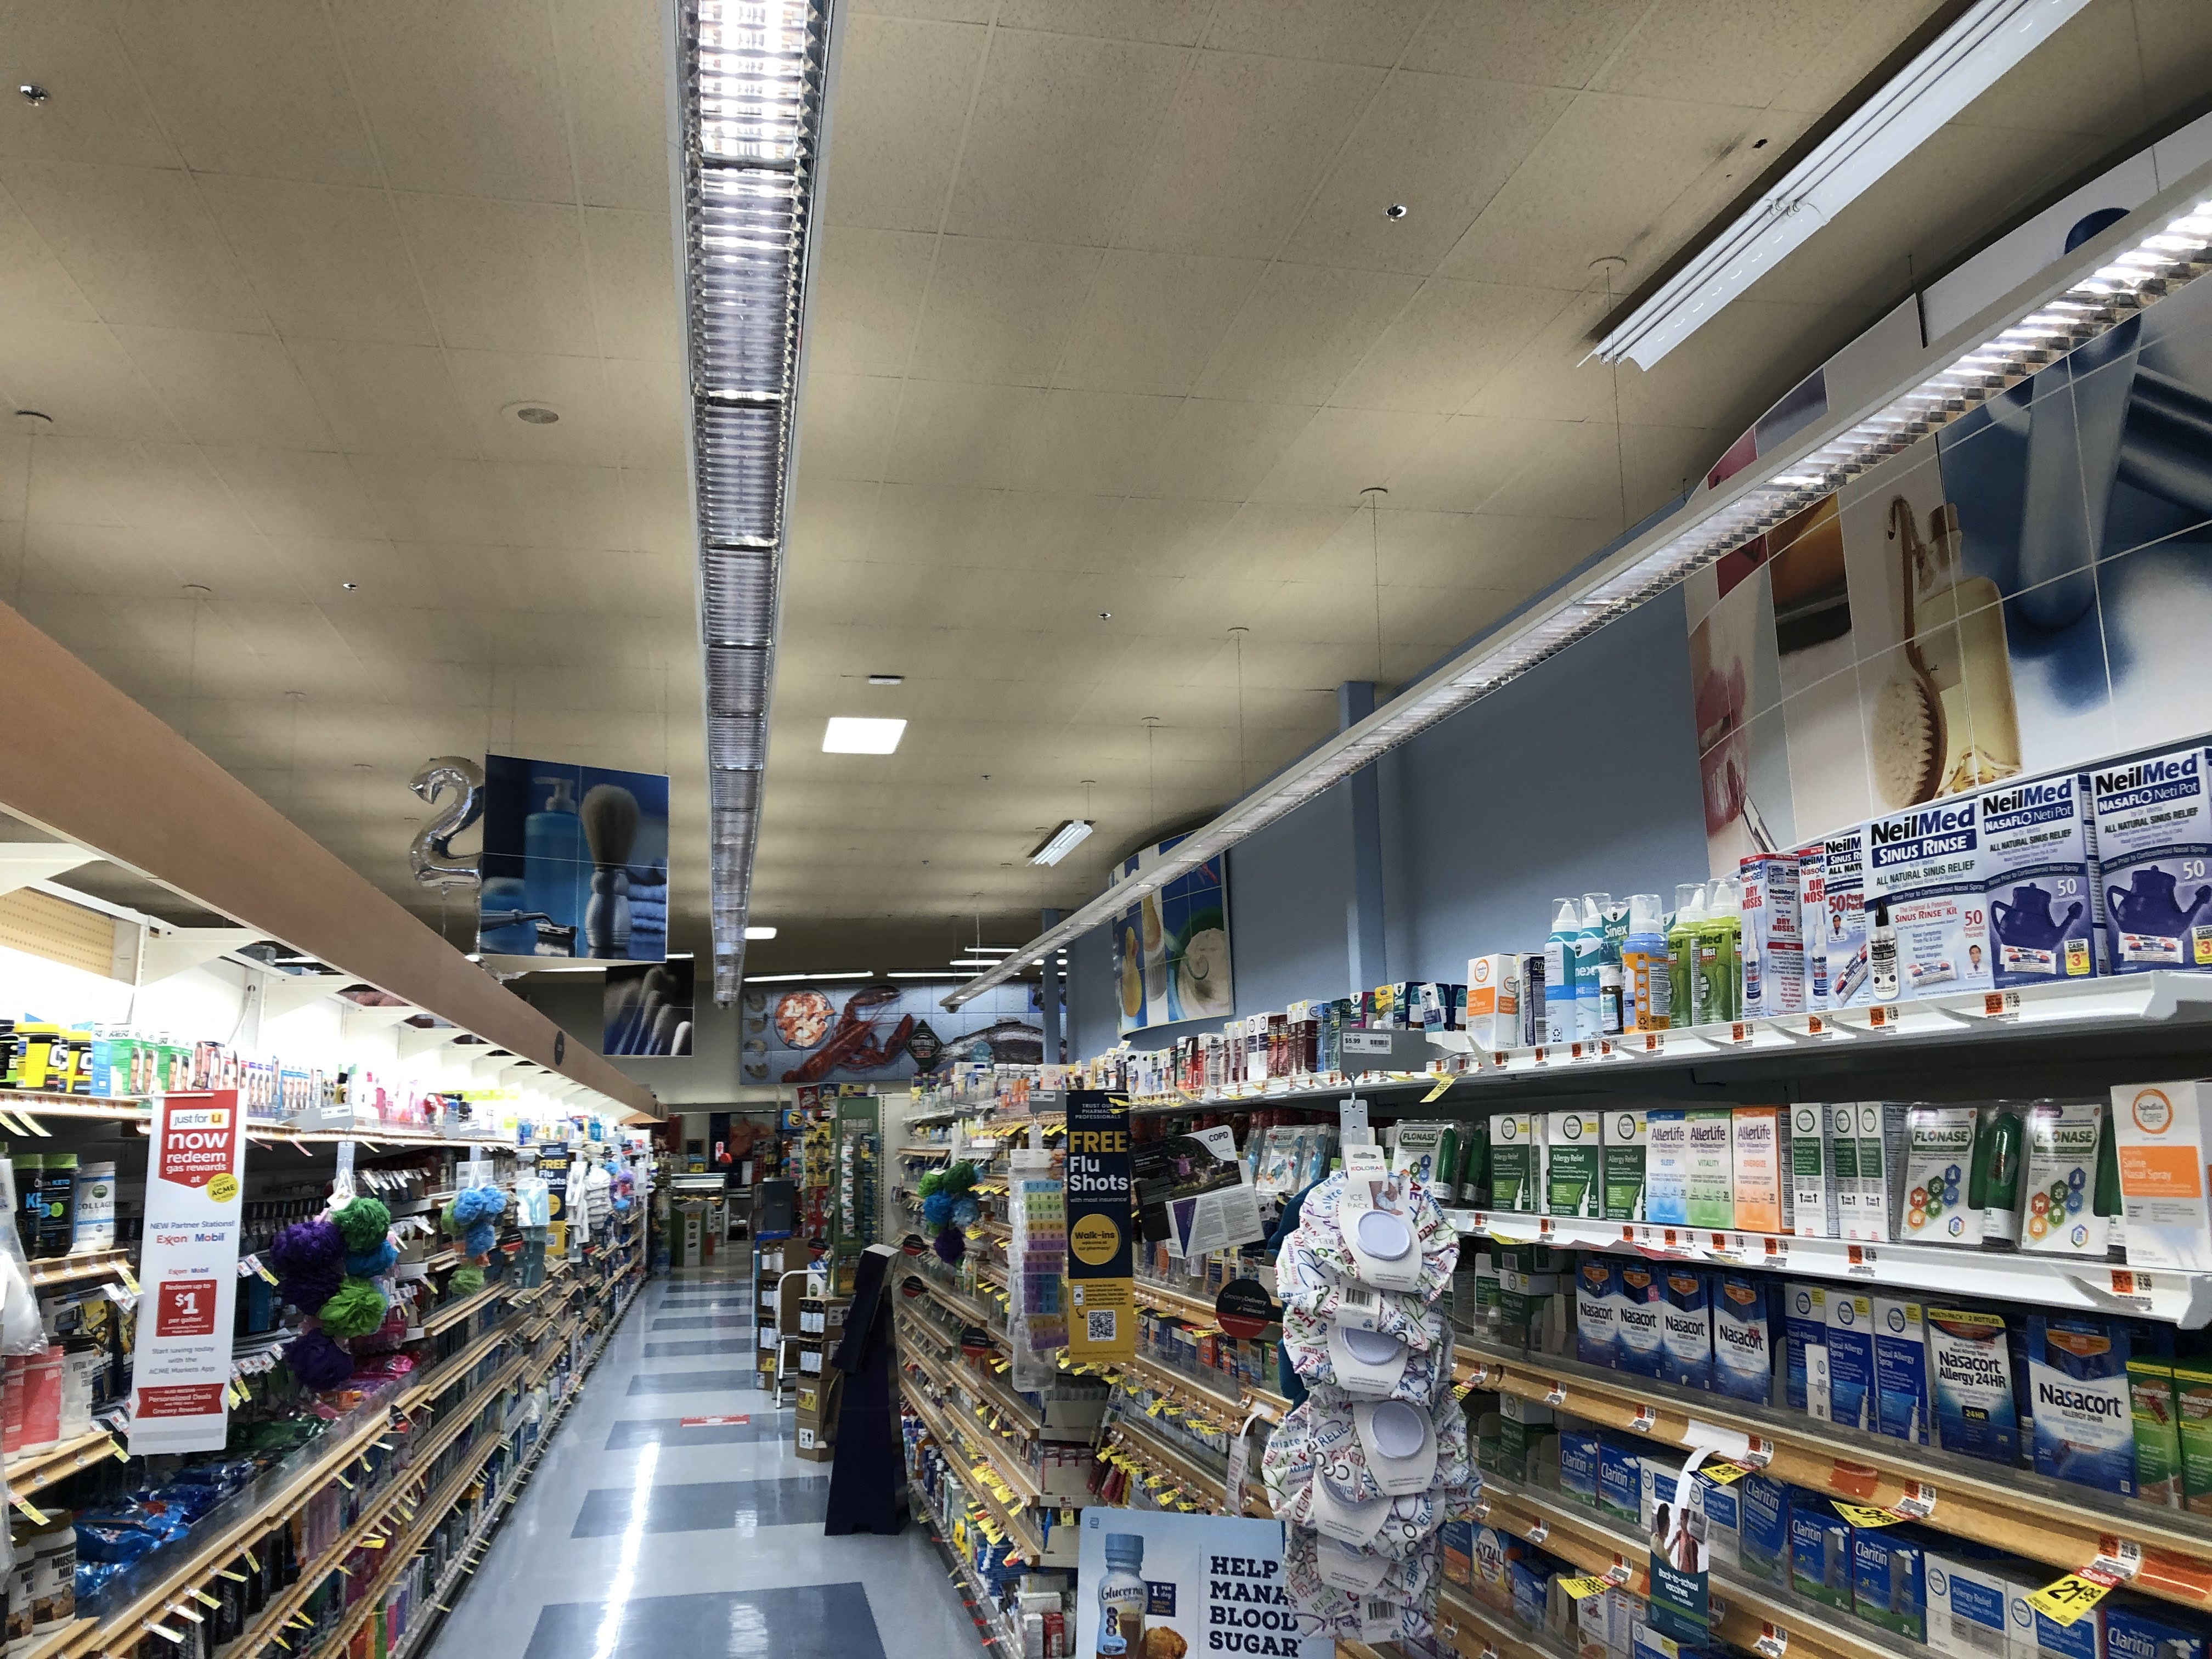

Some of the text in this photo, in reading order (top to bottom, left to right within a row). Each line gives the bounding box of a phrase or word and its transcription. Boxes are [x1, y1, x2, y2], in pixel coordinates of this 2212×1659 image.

[2095, 753, 2197, 795] NeilMed
[1983, 778, 2072, 816] NeilMed
[2100, 782, 2198, 812] NASAFLO Neti Pot
[1871, 803, 1975, 846] NeilMed
[1985, 805, 2072, 831] NASAFLO Neti Pot
[2104, 807, 2198, 833] ALL NATURAL SINUS RELIEF
[2002, 838, 2028, 849] NATURAL
[2030, 833, 2048, 844] SINUS
[2050, 829, 2072, 840] RELIEF
[1879, 836, 1967, 864] SINUS RINSE
[1740, 861, 1763, 874] NeilMed
[1830, 853, 1851, 865] SINUS
[1829, 866, 1842, 875] ALL
[1877, 860, 1974, 885] ALL NATURAL SINUS RELIEF
[2182, 860, 2205, 879] 50
[1746, 885, 1758, 898] DRY
[2058, 878, 2076, 896] 50
[1742, 896, 1762, 911] NOSES
[1829, 895, 1846, 914] 50
[1895, 907, 1957, 923] SINUS RINSE Kit
[1965, 910, 1983, 927] 50
[1605, 924, 1628, 938] Sinex
[1772, 924, 1795, 933] NOSES
[1872, 942, 1895, 952] NeilMed
[174, 1114, 222, 1125] just for u
[167, 1132, 229, 1149] now
[1069, 1131, 1127, 1153] FREE
[1209, 1131, 1228, 1142] COPD
[1914, 1130, 1968, 1142] FLONASE
[2036, 1131, 2092, 1143] FLONASE
[166, 1150, 226, 1163] redeem
[539, 1159, 567, 1169] FREE
[1070, 1155, 1100, 1172] Flu
[1553, 1155, 1570, 1163] Allergy
[1608, 1155, 1624, 1164] Allergy
[2123, 1158, 2146, 1167] Saline
[166, 1163, 227, 1174] gas rewards
[2124, 1169, 2171, 1181] Nasal Spray
[190, 1175, 200, 1183] at
[1070, 1174, 1128, 1191] Shots
[212, 1184, 235, 1197] ACME
[156, 1233, 224, 1246] Exxon Mobil
[1075, 1231, 1115, 1239] Walk-ins
[175, 1293, 199, 1314] $1
[1581, 1302, 1613, 1321] Nasacort
[1621, 1308, 1657, 1328] Nasacort
[1666, 1316, 1705, 1336] Nasacort
[1719, 1324, 1763, 1351] Nasacort
[1844, 1344, 1863, 1355] Allergy
[1894, 1351, 1914, 1364] Allergy
[1939, 1351, 2001, 1374] Nasacort
[1939, 1367, 2006, 1389] Allergy 24HR
[2040, 1383, 2121, 1418] Nasacort
[1966, 1409, 1985, 1419] 24HR
[1562, 1449, 1586, 1472] Claritin
[1601, 1462, 1628, 1487] Claritin
[1746, 1479, 1779, 1511] Claritin
[1792, 1519, 1821, 1543] Claritin
[1855, 1541, 1887, 1566] Claritin
[1210, 1556, 1279, 1579] HELP
[1102, 1585, 1143, 1600] Glucerna
[1152, 1585, 1158, 1596] 1
[1210, 1581, 1288, 1605] MANA
[1210, 1605, 1299, 1632] BLOOD
[2108, 1627, 2154, 1658] Claritin
